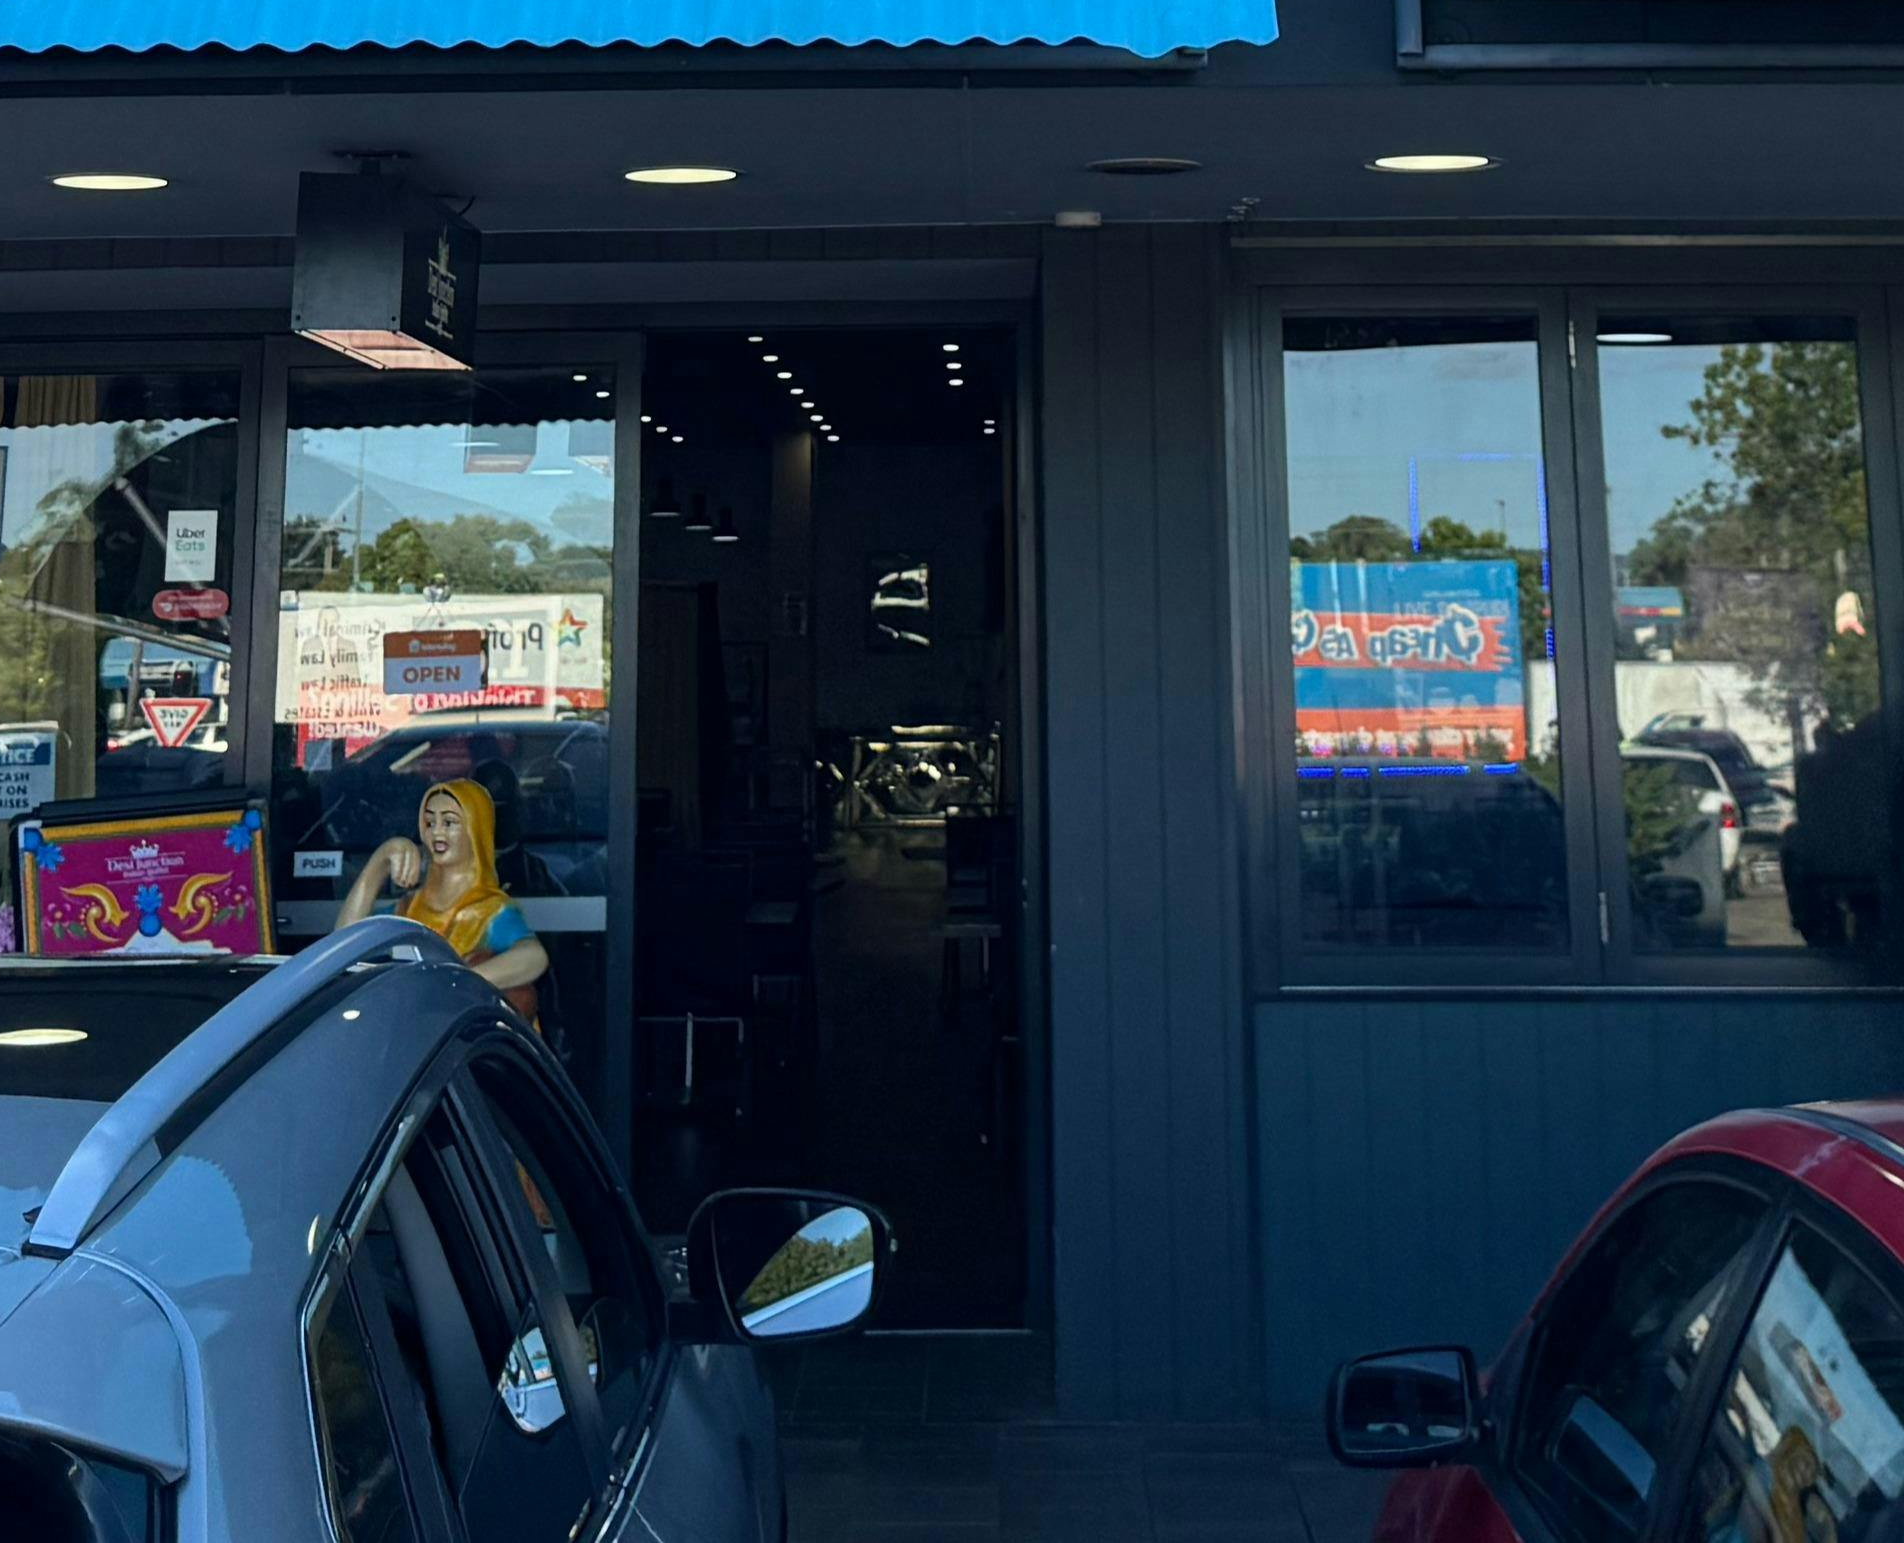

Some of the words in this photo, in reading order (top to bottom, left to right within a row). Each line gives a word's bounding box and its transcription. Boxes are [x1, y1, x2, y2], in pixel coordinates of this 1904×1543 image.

[176, 528, 205, 538] Uber
[175, 539, 206, 551] Eats
[402, 665, 461, 684] OPEN
[6, 785, 27, 795] ON
[302, 858, 336, 869] PUSH
